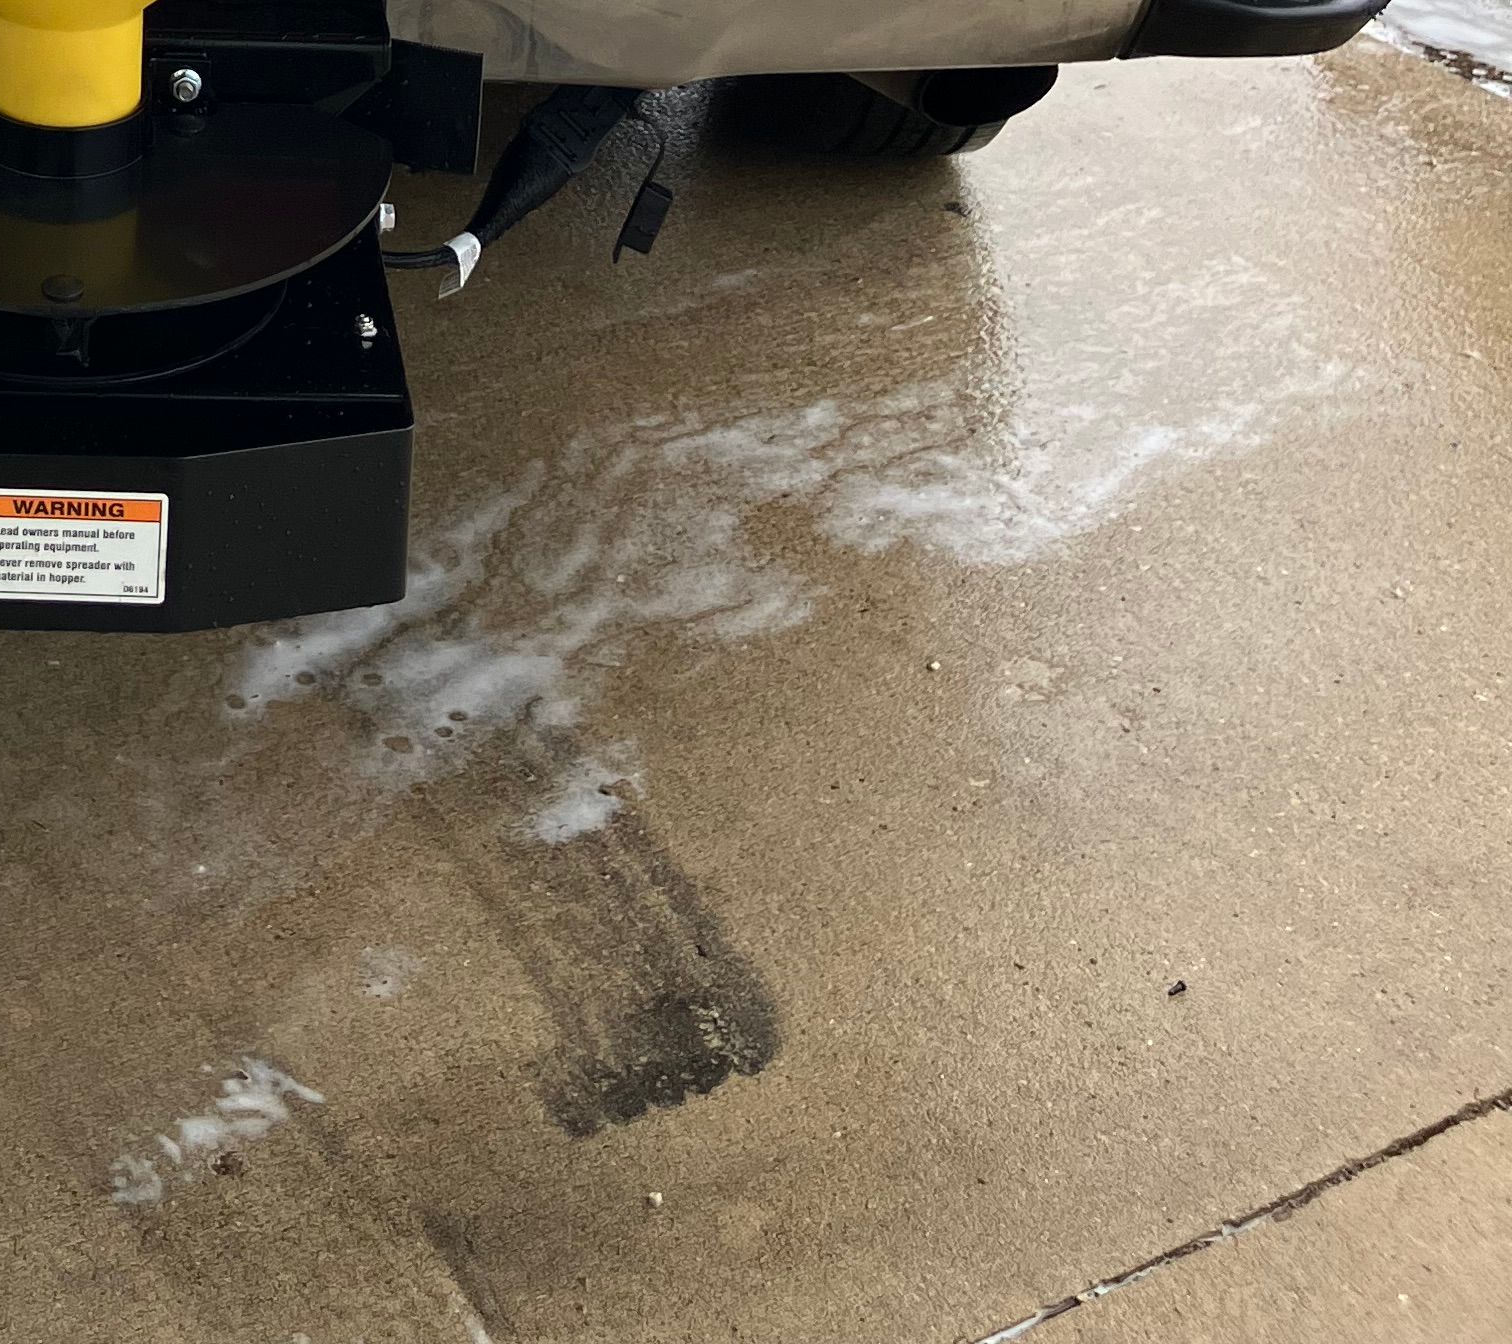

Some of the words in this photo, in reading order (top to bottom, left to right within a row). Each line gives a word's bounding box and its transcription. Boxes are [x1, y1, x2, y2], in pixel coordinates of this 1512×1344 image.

[12, 499, 125, 518] WARNING
[22, 528, 59, 538] owners
[62, 528, 100, 539] manual
[102, 529, 136, 540] before
[43, 542, 100, 553] equipment.
[24, 559, 63, 569] remove
[65, 560, 111, 571] spreader
[114, 561, 135, 571] with
[36, 572, 46, 582] in
[48, 573, 86, 585] hopper.
